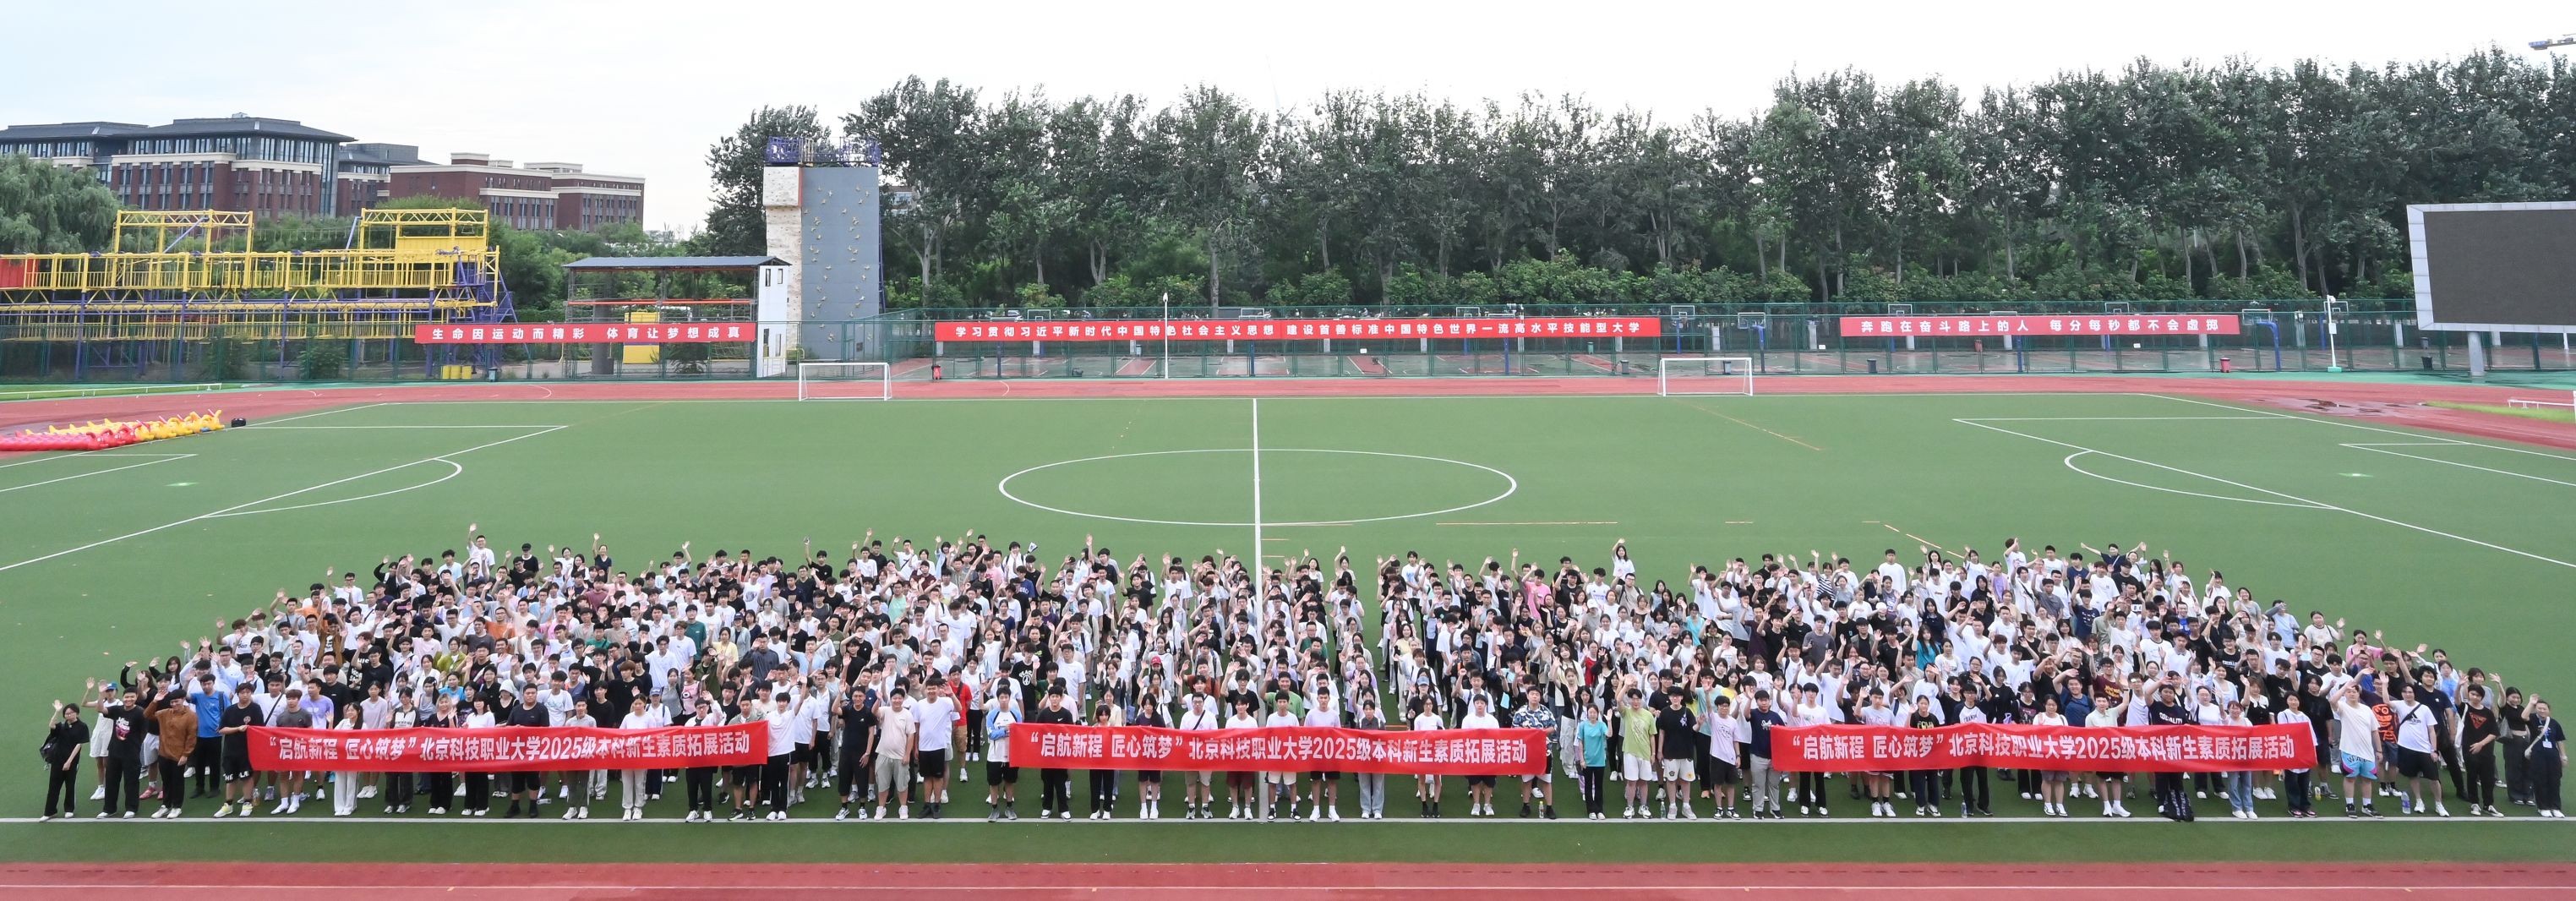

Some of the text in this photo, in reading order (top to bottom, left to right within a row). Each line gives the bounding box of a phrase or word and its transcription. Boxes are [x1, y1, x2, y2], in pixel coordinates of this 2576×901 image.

[432, 326, 740, 341] 生命因运动而精彩 体育让梦想成真
[955, 322, 1640, 338] 学习贯彻习近平新时代中国特色社会主义思想 建设首善标准中国特色世界一流高水平技能型大学
[1861, 319, 2219, 333] 奔跑在奋斗路上的人 每分每秒都不会虚掷
